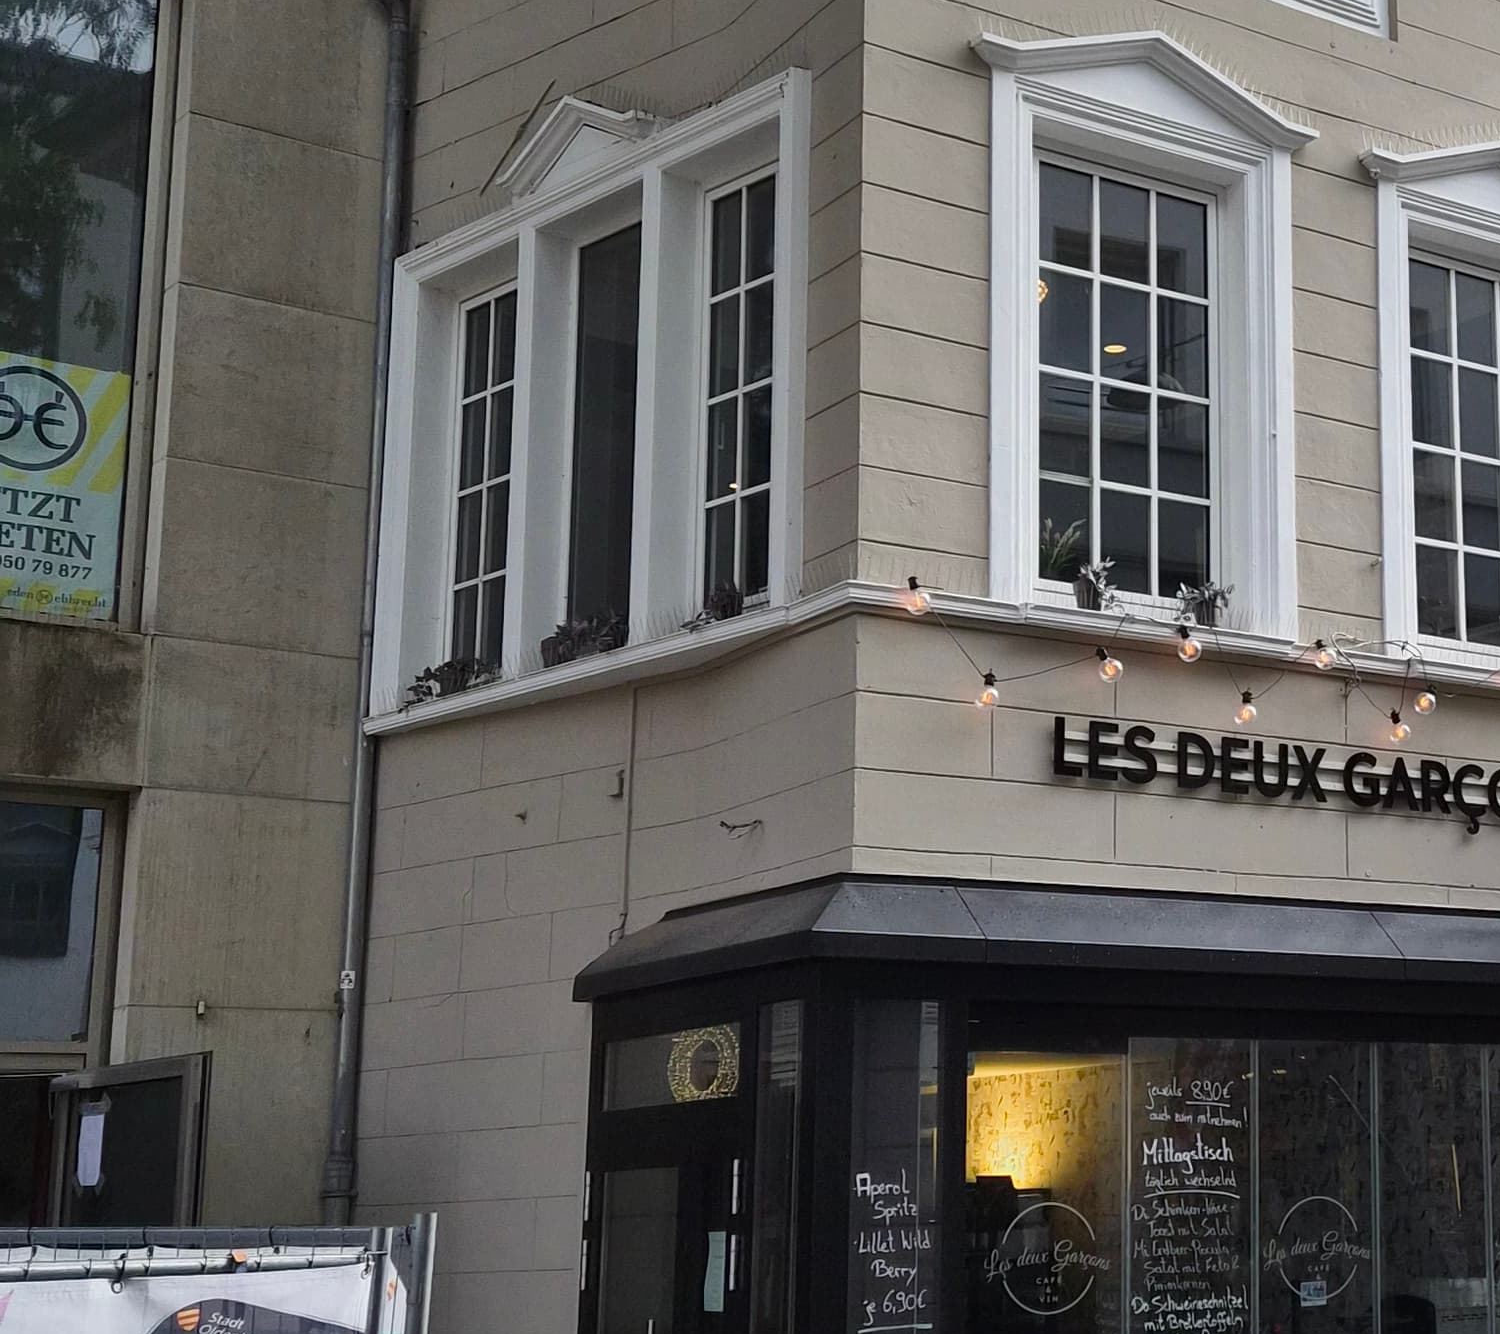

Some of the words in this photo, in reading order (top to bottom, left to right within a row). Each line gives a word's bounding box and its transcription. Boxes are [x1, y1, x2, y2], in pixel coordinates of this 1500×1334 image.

[0, 486, 80, 523] TZT
[0, 555, 25, 574] 50
[32, 558, 53, 576] 79
[58, 563, 92, 580] 877
[1053, 715, 1158, 784] LES
[1176, 730, 1329, 804] DEUX
[1144, 1076, 1183, 1110] jeweils
[1149, 1106, 1171, 1123] auch
[1174, 1112, 1193, 1123] zum
[1142, 1132, 1234, 1175] Mittagstisch
[856, 1168, 911, 1203] Aperol
[1144, 1168, 1179, 1193] täglich
[1184, 1166, 1237, 1188] wechselnd
[873, 1197, 918, 1225] Spritz
[858, 1230, 896, 1254] Lillet
[901, 1229, 932, 1251] Wild
[871, 1259, 918, 1287] Berry
[984, 1249, 1013, 1283] Les
[1016, 1247, 1049, 1267] deux
[1050, 1239, 1110, 1272] Garçons
[208, 1311, 245, 1331] Stadt
[863, 1299, 877, 1327] je
[882, 1288, 927, 1315] 6,90€
[1144, 1318, 1165, 1332] mit
